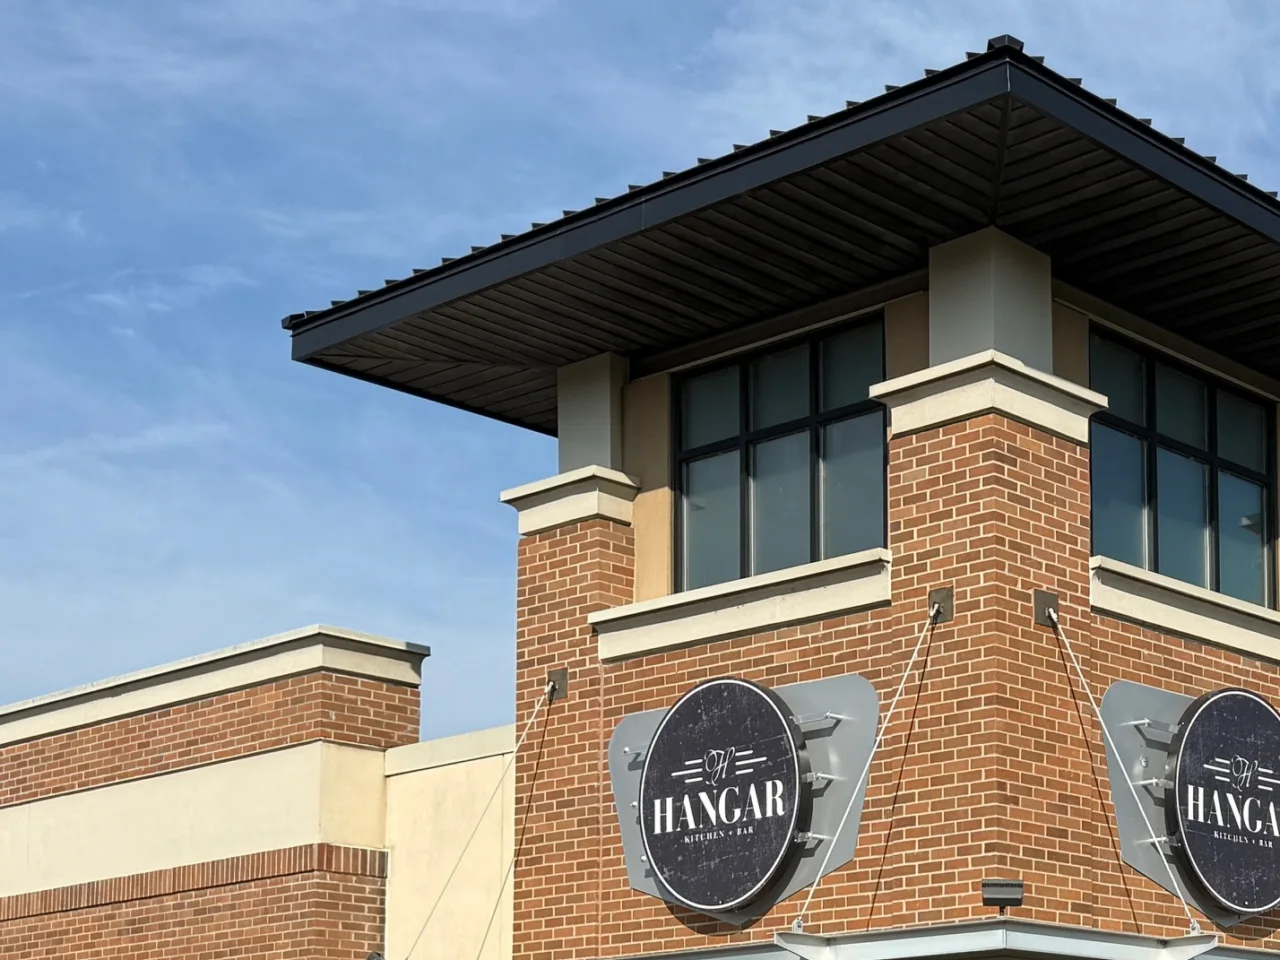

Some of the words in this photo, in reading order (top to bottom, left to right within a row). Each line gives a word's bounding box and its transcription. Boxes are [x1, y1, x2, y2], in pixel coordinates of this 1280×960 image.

[653, 779, 785, 835] HANGAR
[684, 830, 724, 844] KITCHEN
[737, 826, 754, 836] BAR
[1213, 830, 1248, 844] KITCHEN
[1259, 839, 1273, 848] BAR
